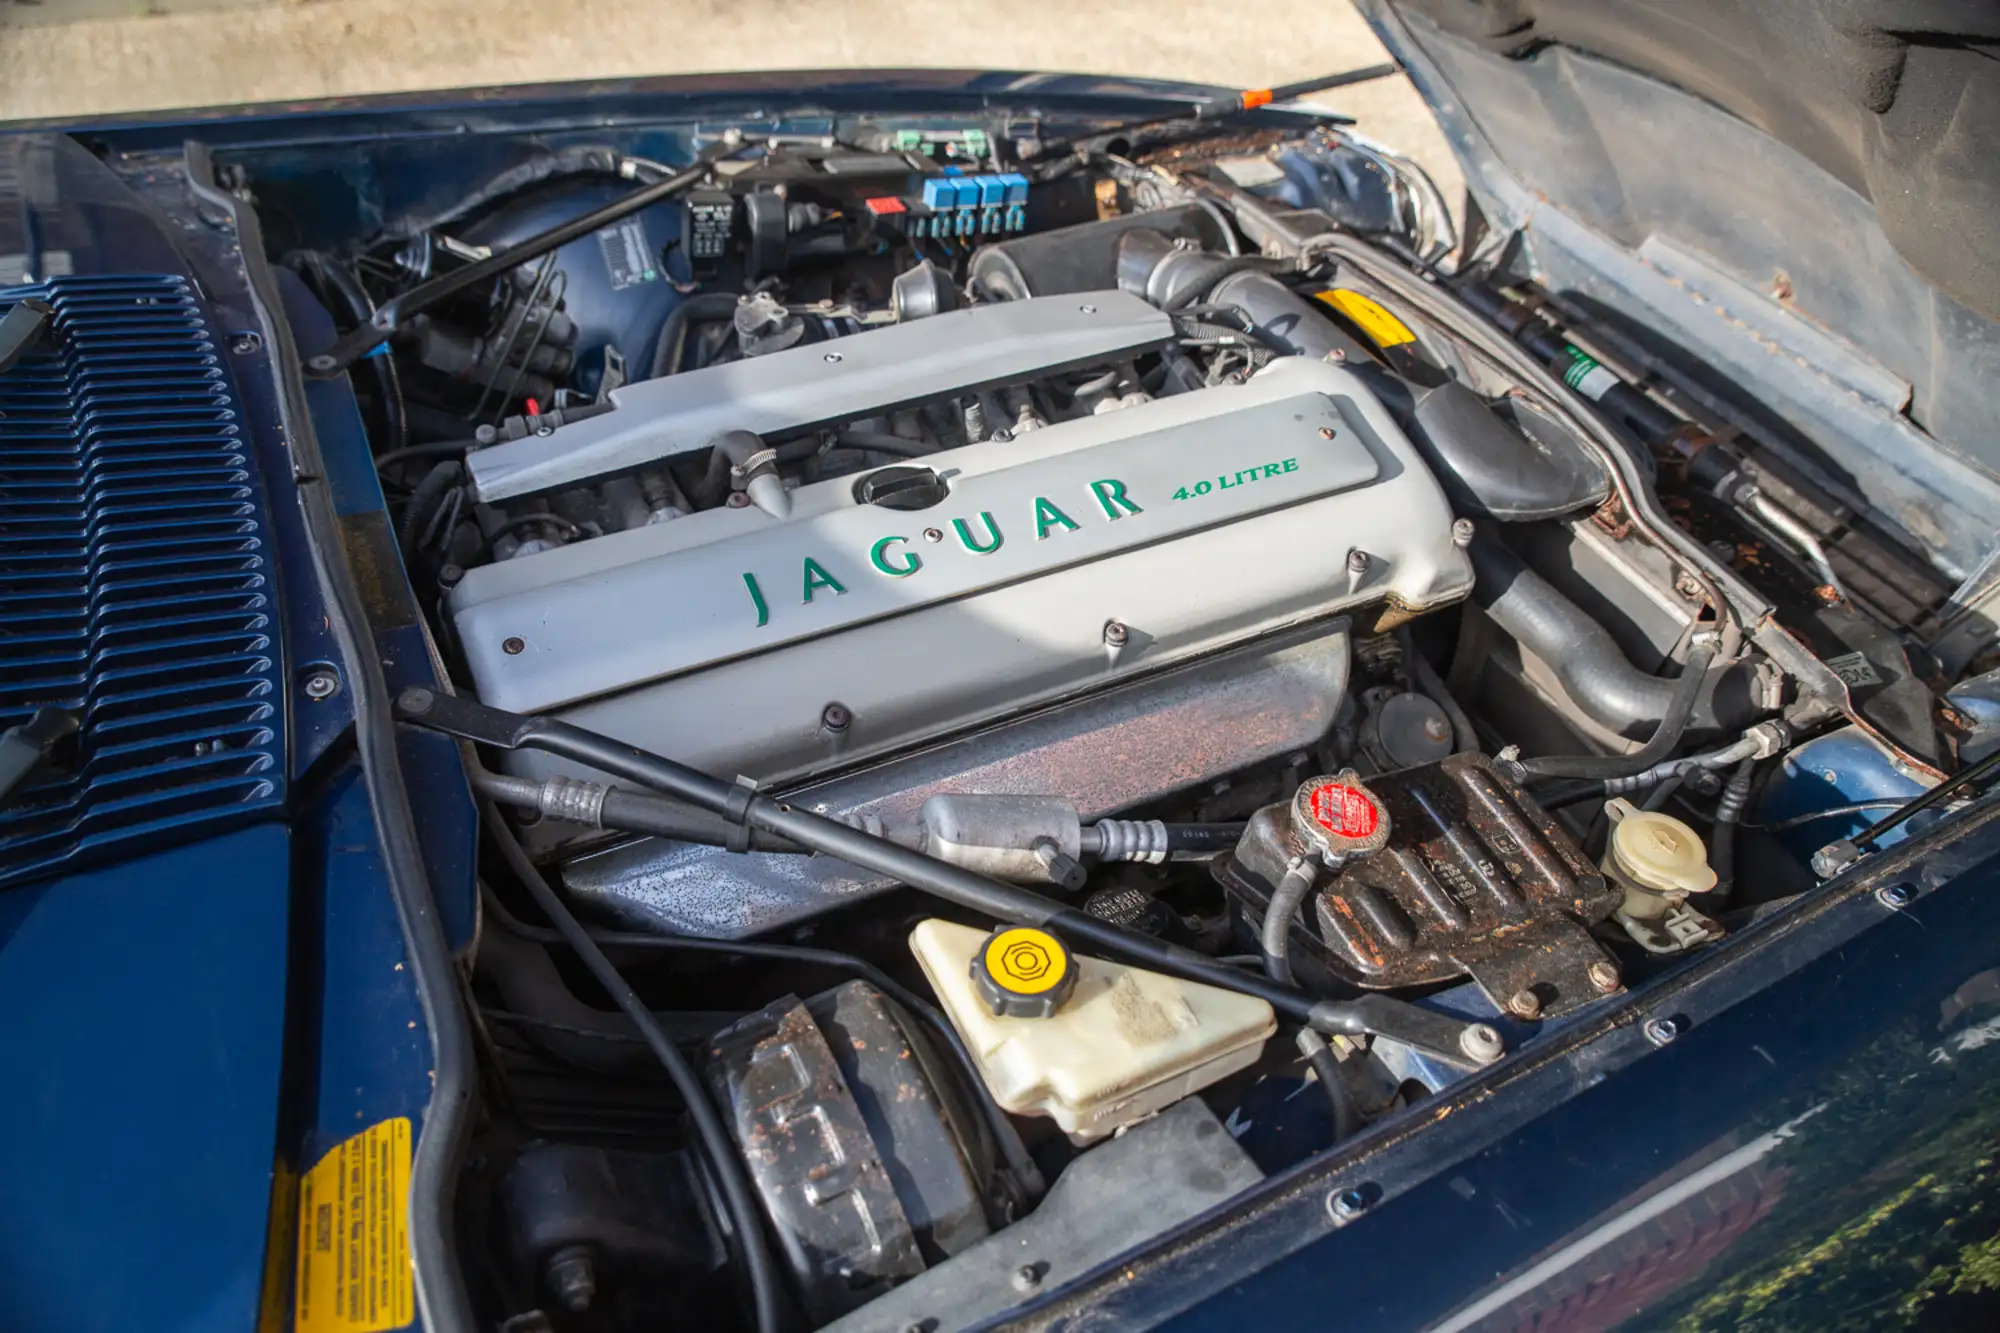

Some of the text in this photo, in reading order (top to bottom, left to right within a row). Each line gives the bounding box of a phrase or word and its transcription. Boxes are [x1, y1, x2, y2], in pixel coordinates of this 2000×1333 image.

[1172, 457, 1300, 501] 4.0 LITRE
[742, 478, 1142, 628] JAGUAR
